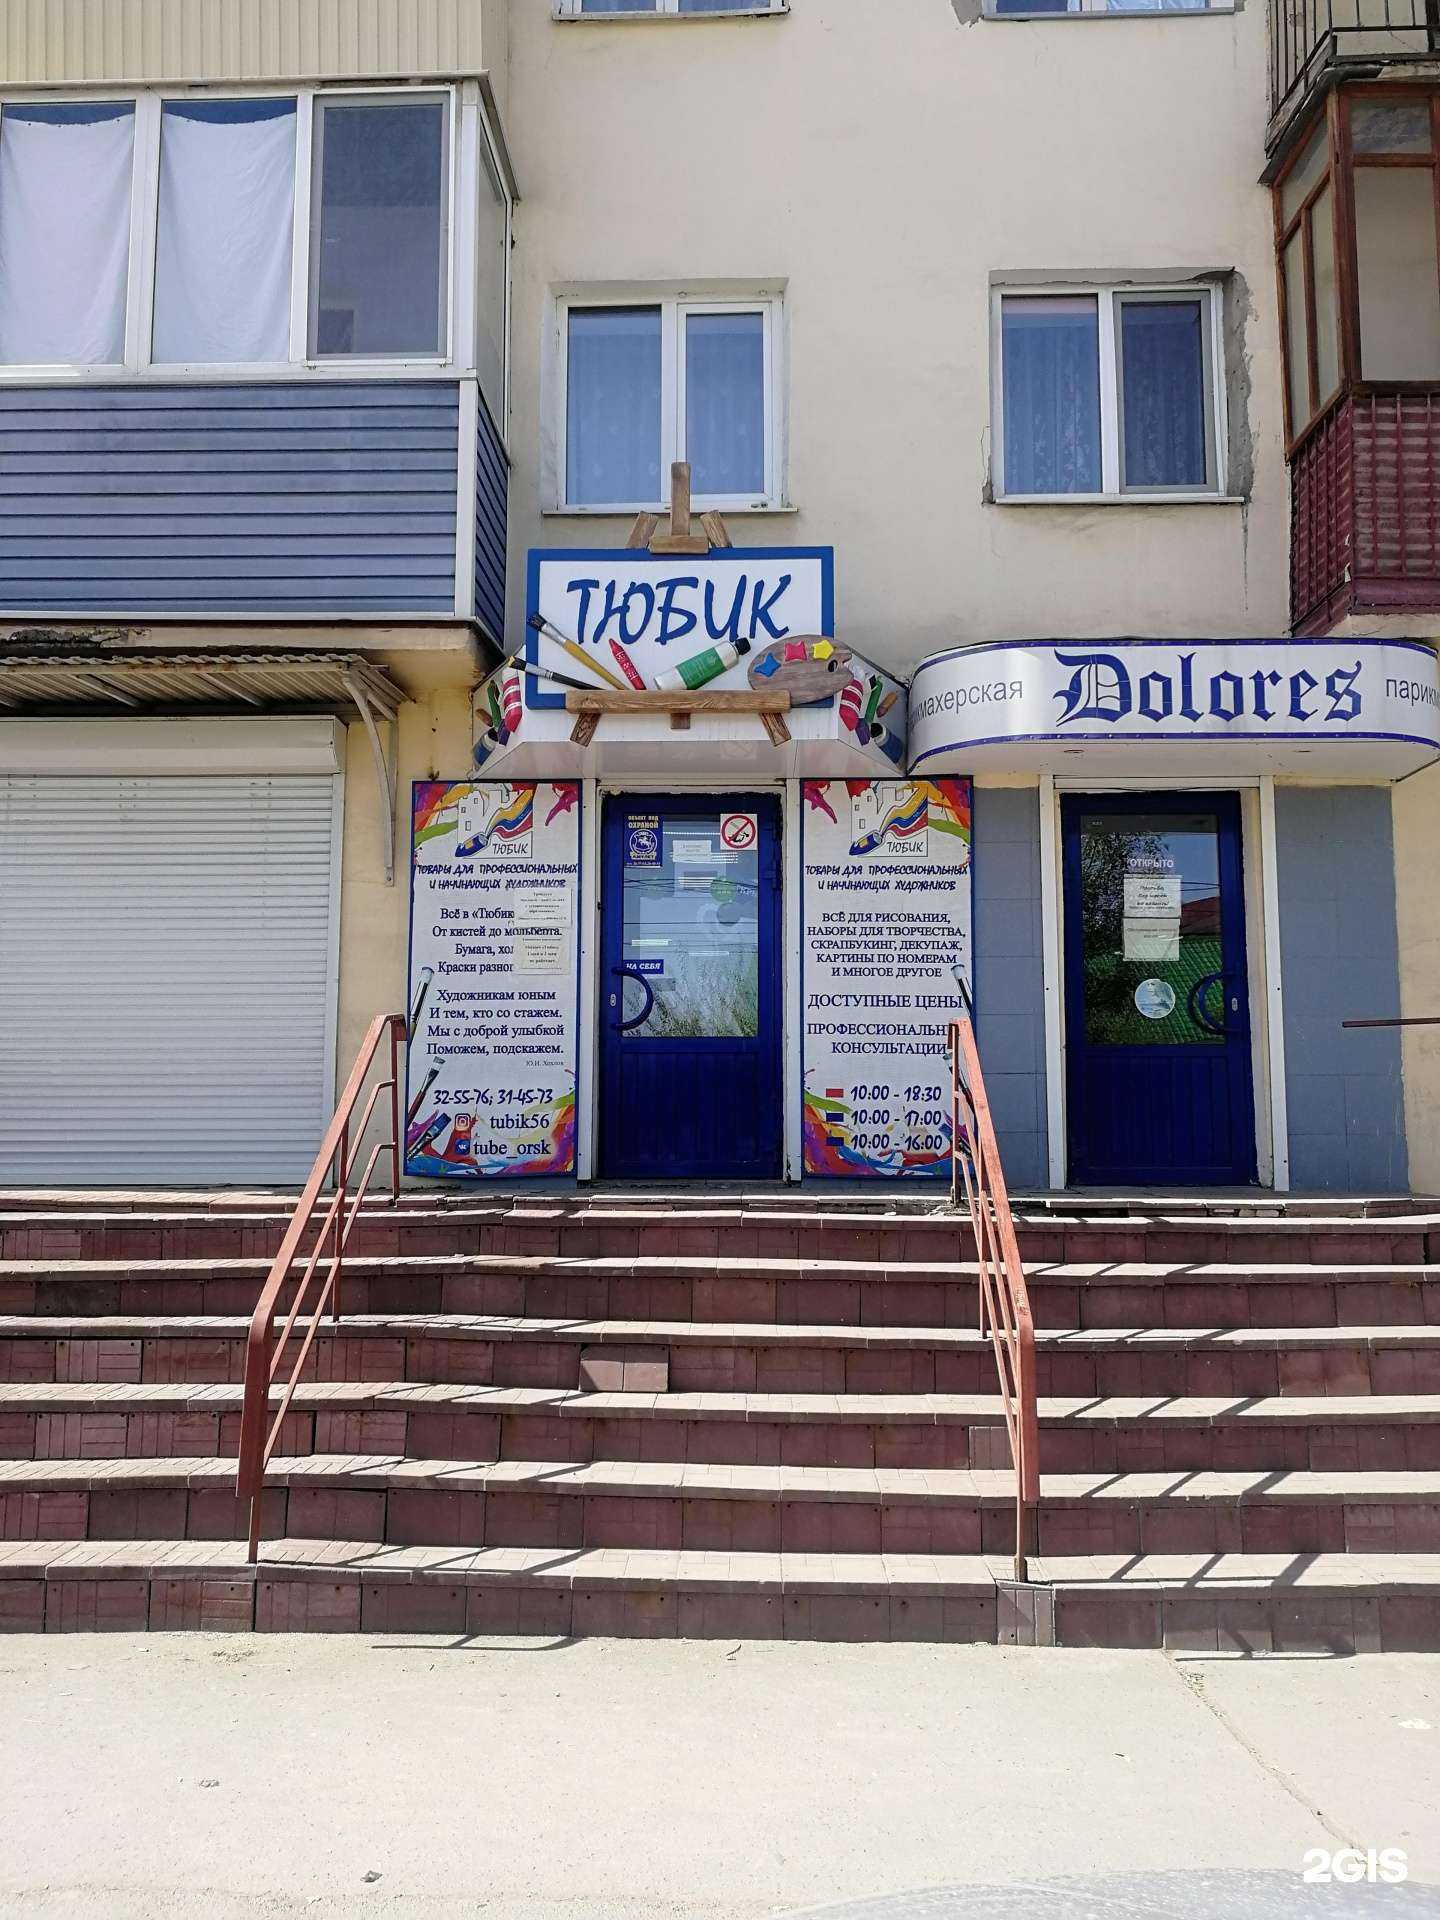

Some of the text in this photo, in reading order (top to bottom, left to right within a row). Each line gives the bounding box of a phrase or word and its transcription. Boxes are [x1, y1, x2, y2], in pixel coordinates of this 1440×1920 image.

[566, 574, 792, 646] ТЮБИК
[1052, 646, 1364, 728] Dolores
[628, 820, 659, 829] ОХРАНОЙ
[492, 842, 529, 855] ТЮБИК
[887, 841, 924, 853] ТЮБИК
[417, 863, 578, 877] ТОВАРЫ ДЛЯ ПРОФЕССИОНАЛЬНЫХ
[1129, 858, 1175, 869] ОТКРЫТО
[805, 864, 968, 878] ТОВАРЫ ДЛЯ ПРОФЕССИОНАЛЬНЫХ
[429, 879, 566, 893] И НАЧИНАЮЩИХ ХУДОЖНИКОВ
[818, 879, 956, 893] И НАЧИНАЮЩИХ ХУДОЖНИКОВ
[440, 907, 461, 920] Всё
[463, 911, 469, 919] в
[822, 911, 951, 924] ВСЁ ДЛЯ РИСОВАНИЯ,
[432, 925, 449, 937] От
[450, 925, 486, 937] кистей
[489, 927, 502, 938] до
[807, 926, 966, 937] НАБОРЫ ДЛЯ ТВОРЧЕСТВА,
[455, 943, 496, 957] Бумага,
[811, 940, 963, 951] СКРАПБУКИНГ, ДЕКУПАЖ,
[816, 953, 957, 963] КАРТИНЫ ПО НОМЕРАМ
[438, 961, 476, 975] Краски
[625, 962, 661, 970] НА СЕБЯ
[831, 967, 942, 979] И МНОГОЕ ДРУГОЕ
[437, 989, 556, 1002] Художникам юным
[807, 994, 964, 1010] ДОСТУПНЫЕ ЦЕНЫ
[430, 1007, 562, 1020] И тем, кто со стажем.
[427, 1024, 564, 1039] Мы с доброй улыбкой
[807, 1023, 950, 1036] ПРОФЕССИОНАЛЬН
[426, 1043, 564, 1056] Поможем, подскажем.
[832, 1042, 948, 1056] КОНСУЛЬТАЦИИ
[497, 1088, 553, 1105] 31-45-73
[850, 1085, 890, 1101] 10:00
[903, 1085, 942, 1102] 18:30
[490, 1113, 550, 1129] tubik56
[850, 1109, 890, 1126] 10:00
[904, 1110, 942, 1127] 17:00
[473, 1139, 552, 1159] tube_orsk
[850, 1133, 890, 1150] 10:00
[904, 1134, 943, 1151] 16:00
